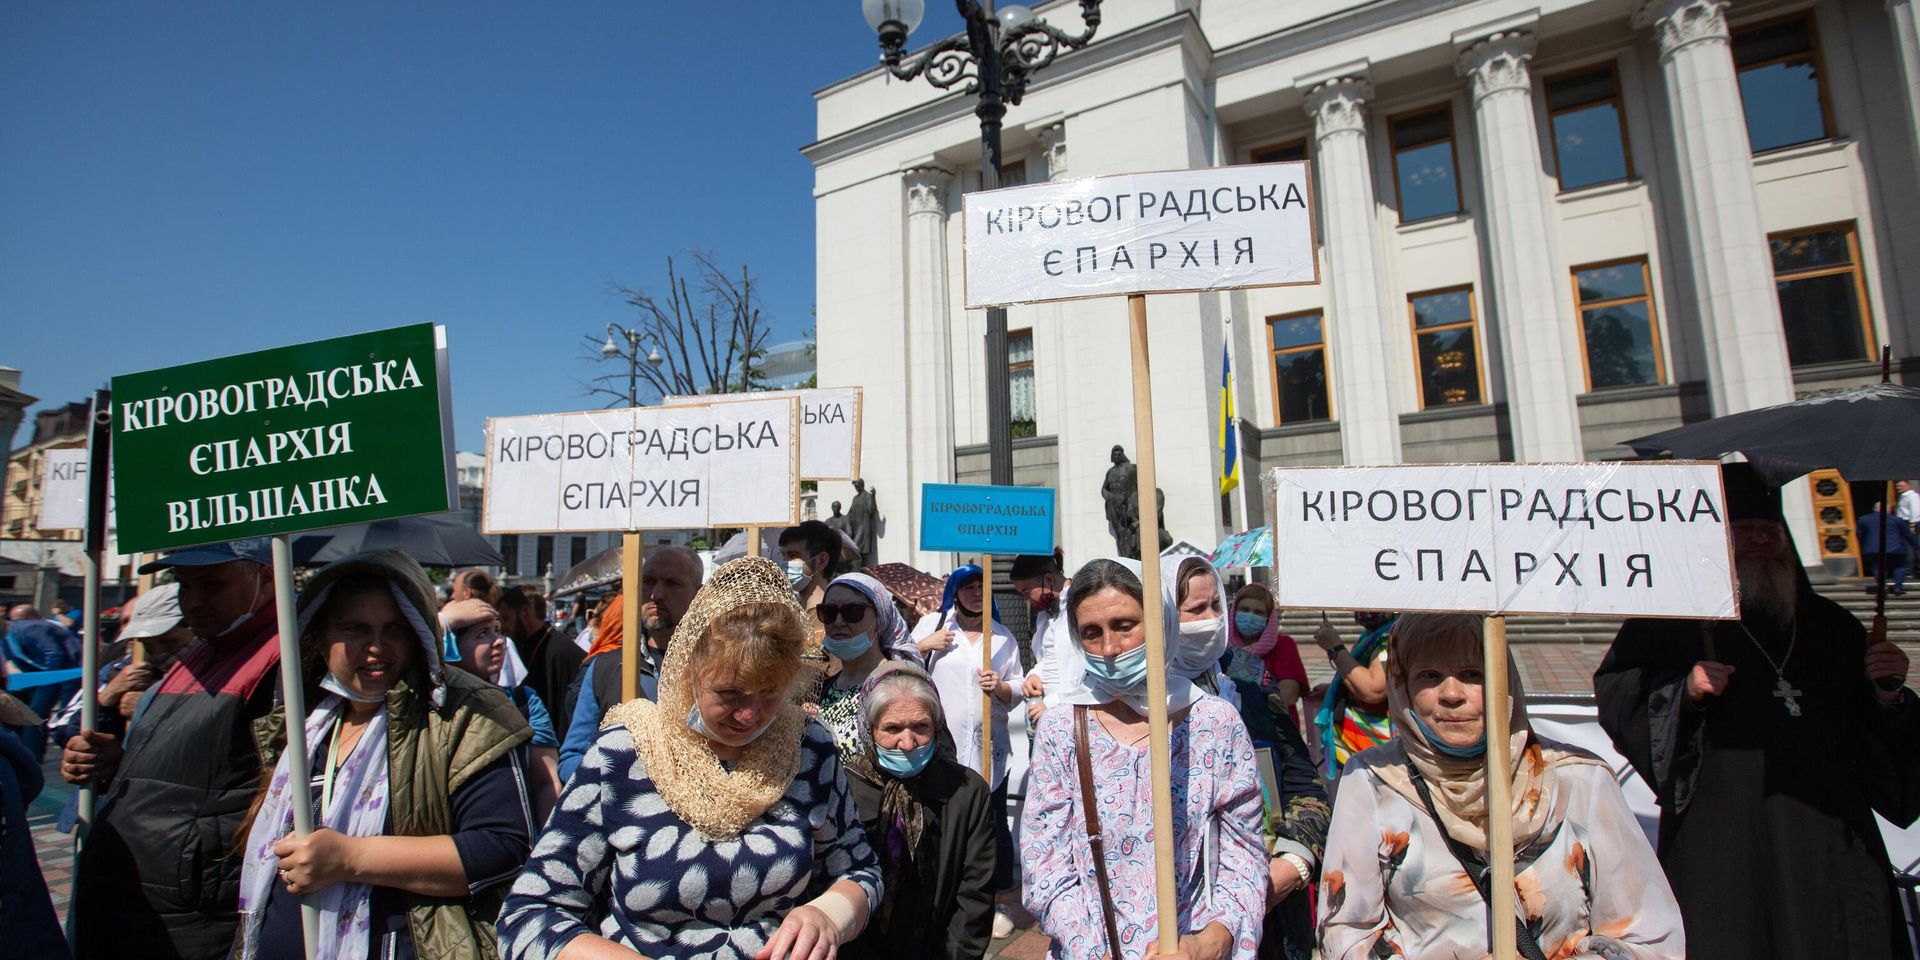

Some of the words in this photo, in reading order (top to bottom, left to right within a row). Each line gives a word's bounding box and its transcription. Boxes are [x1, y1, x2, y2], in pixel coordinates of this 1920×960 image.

[986, 182, 1307, 235] КІРОВОГРАДСЬКА
[1043, 236, 1255, 277] ЄПАРХІЯ
[121, 356, 424, 433] КІРОВОГРАДСЬКА
[800, 403, 845, 425] ЬКА
[189, 421, 354, 475] ЄПАРХІЯ
[499, 419, 779, 463] КІРОВОГРАДСЬКА
[166, 472, 388, 533] ВІЛЬШАНКА
[562, 479, 701, 510] ЄПАРХІЯ
[930, 501, 1047, 517] КІРОВОГРАДСЬКА
[1301, 488, 1722, 530] КІРОВОГРАДСЬКА
[957, 524, 1018, 537] ЄПАРХІЯ
[1373, 548, 1653, 588] ЄПАРХІЯ
